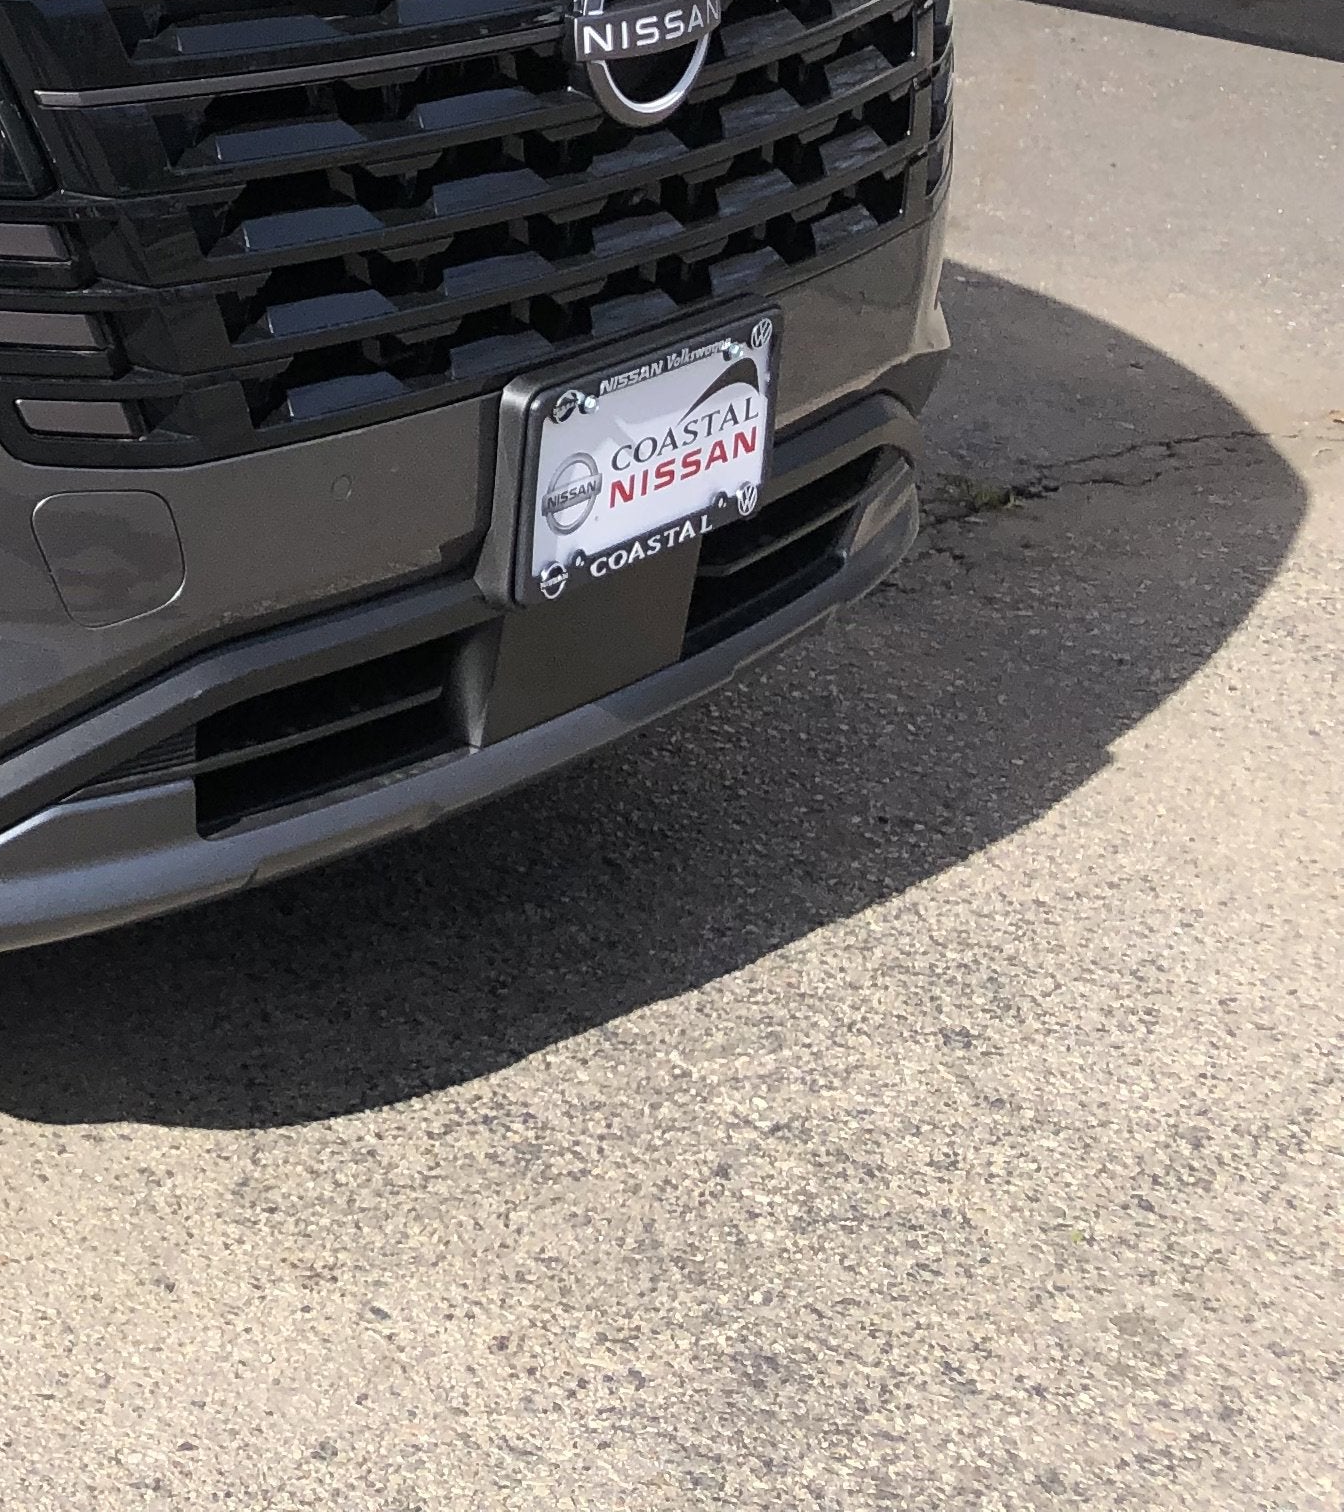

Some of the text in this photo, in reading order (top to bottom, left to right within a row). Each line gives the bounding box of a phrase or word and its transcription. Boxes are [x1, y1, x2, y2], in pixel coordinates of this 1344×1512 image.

[599, 359, 664, 396] NISSAN
[610, 396, 760, 472] COASTAL
[547, 479, 598, 510] NISSAN
[609, 425, 758, 510] NISSAN
[589, 514, 713, 578] COASTAL
